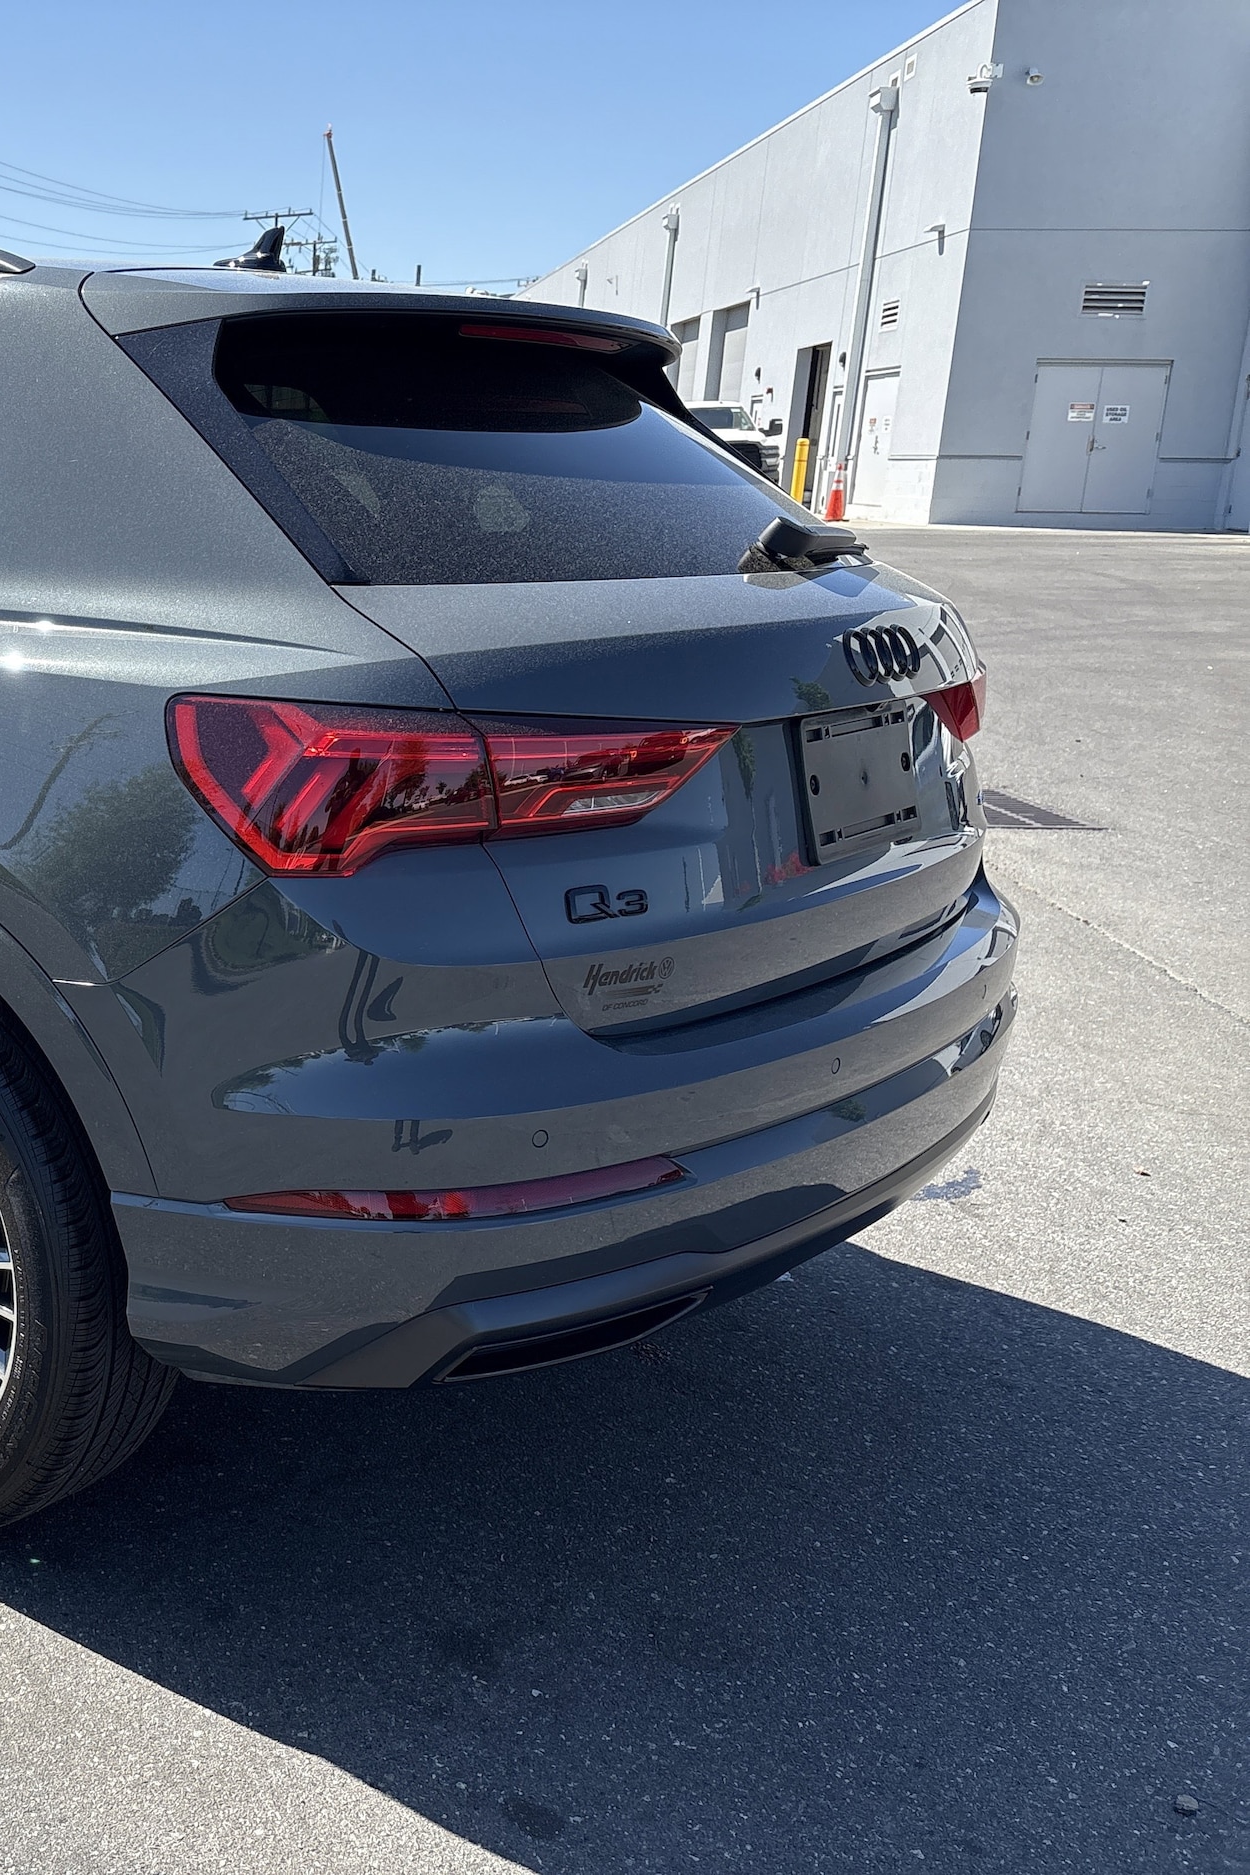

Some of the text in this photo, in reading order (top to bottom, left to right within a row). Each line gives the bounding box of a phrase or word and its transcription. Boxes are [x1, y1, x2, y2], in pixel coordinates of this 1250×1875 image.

[564, 884, 648, 924] Q3
[582, 961, 658, 996] Hendrick
[613, 999, 649, 1010] CONCORD
